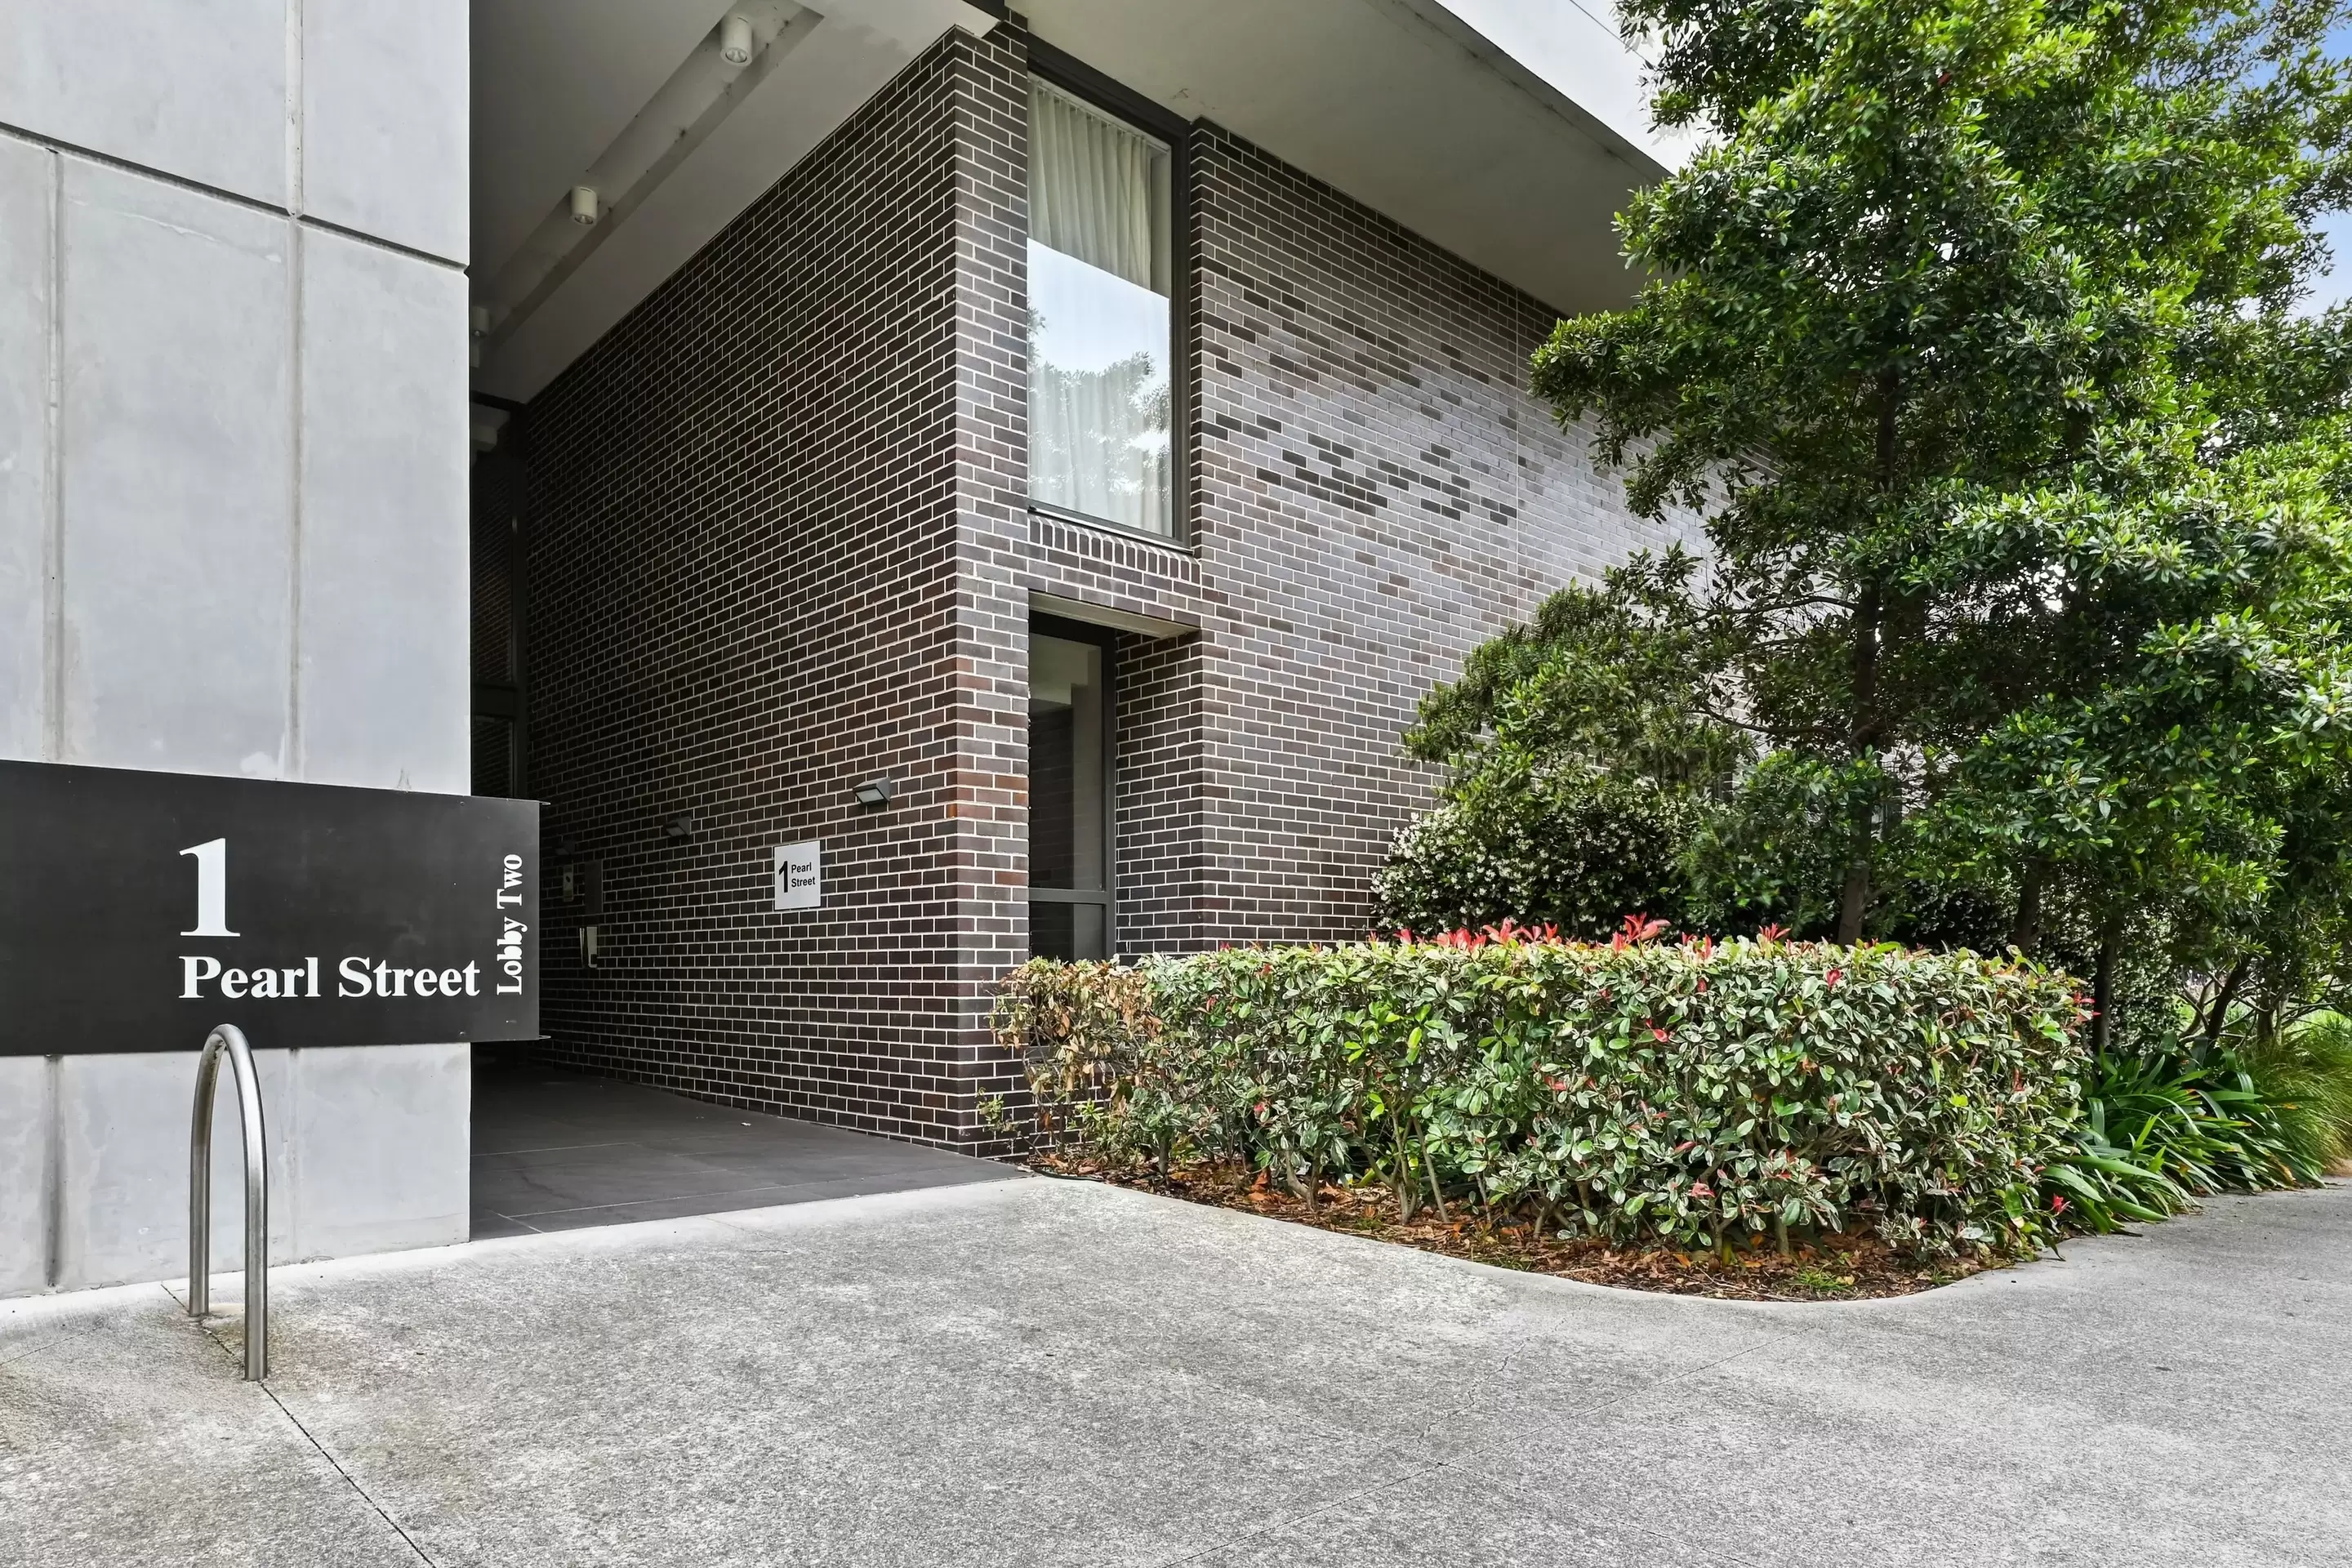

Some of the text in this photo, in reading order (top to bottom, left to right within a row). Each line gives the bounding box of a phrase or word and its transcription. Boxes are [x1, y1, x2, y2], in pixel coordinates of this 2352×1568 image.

[778, 860, 789, 893] 1
[791, 862, 813, 874] Pearl
[791, 875, 816, 888] Street
[179, 837, 241, 938] 1
[497, 853, 528, 996] Lobby Two
[178, 956, 481, 999] Pearl Street
